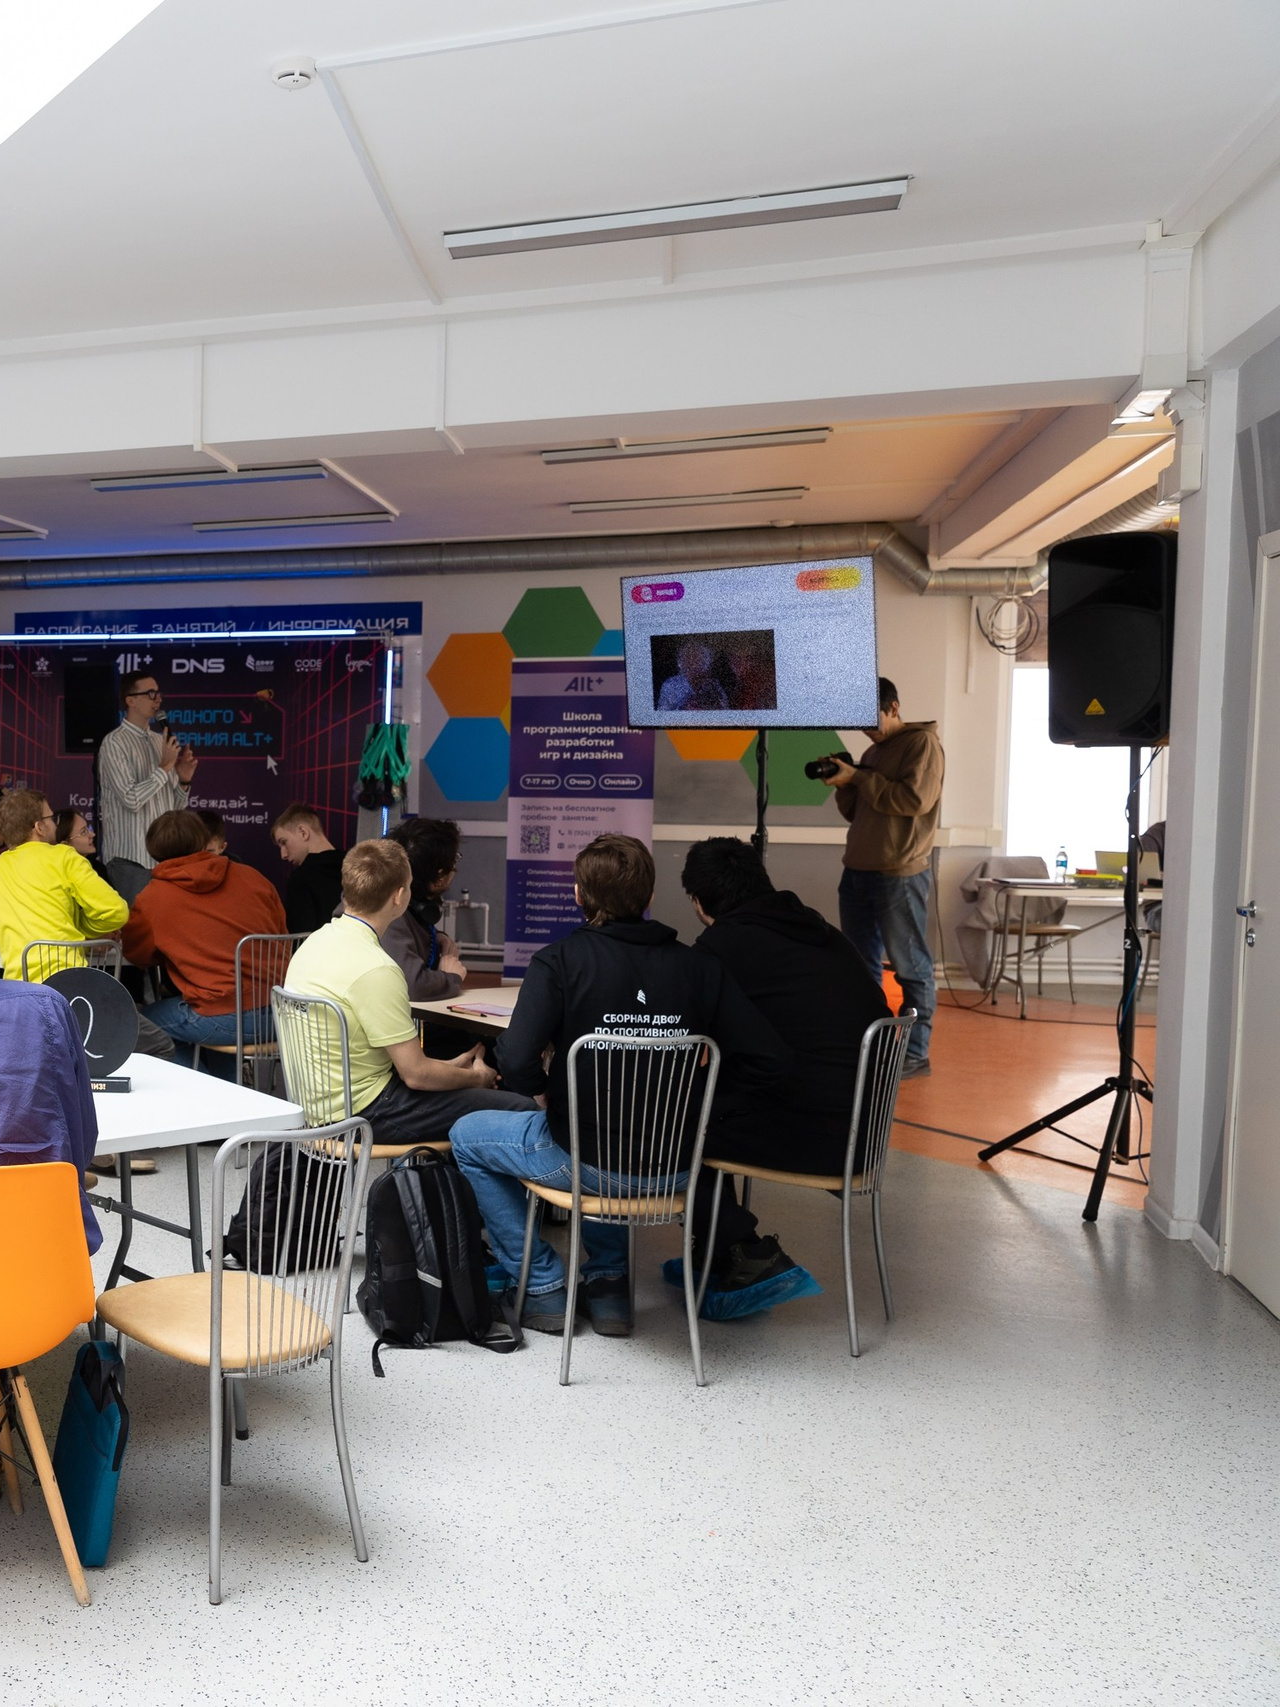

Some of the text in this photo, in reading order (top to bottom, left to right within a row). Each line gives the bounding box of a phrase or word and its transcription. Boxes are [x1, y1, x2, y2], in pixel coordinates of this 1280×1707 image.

[24, 624, 138, 636] РАСПИСАНИЕ
[152, 620, 236, 634] ЗАНЯТИЙ
[268, 617, 409, 631] ИНФОРМАЦИЯ
[172, 658, 225, 674] DNS
[294, 659, 322, 668] CODE
[562, 712, 602, 721] Школа
[546, 737, 615, 748] разработки
[539, 750, 624, 761] игр и дизайна
[604, 777, 636, 786] Онлайн
[187, 795, 248, 809] беждай
[521, 804, 551, 812] Запись
[565, 804, 616, 813] бесплатное
[520, 813, 558, 822] пробное
[1124, 938, 1132, 949] 2
[603, 1013, 682, 1026] СБОРНАЯ ДВФУ
[595, 1026, 690, 1038] ПО СПОРТИВНОМУ
